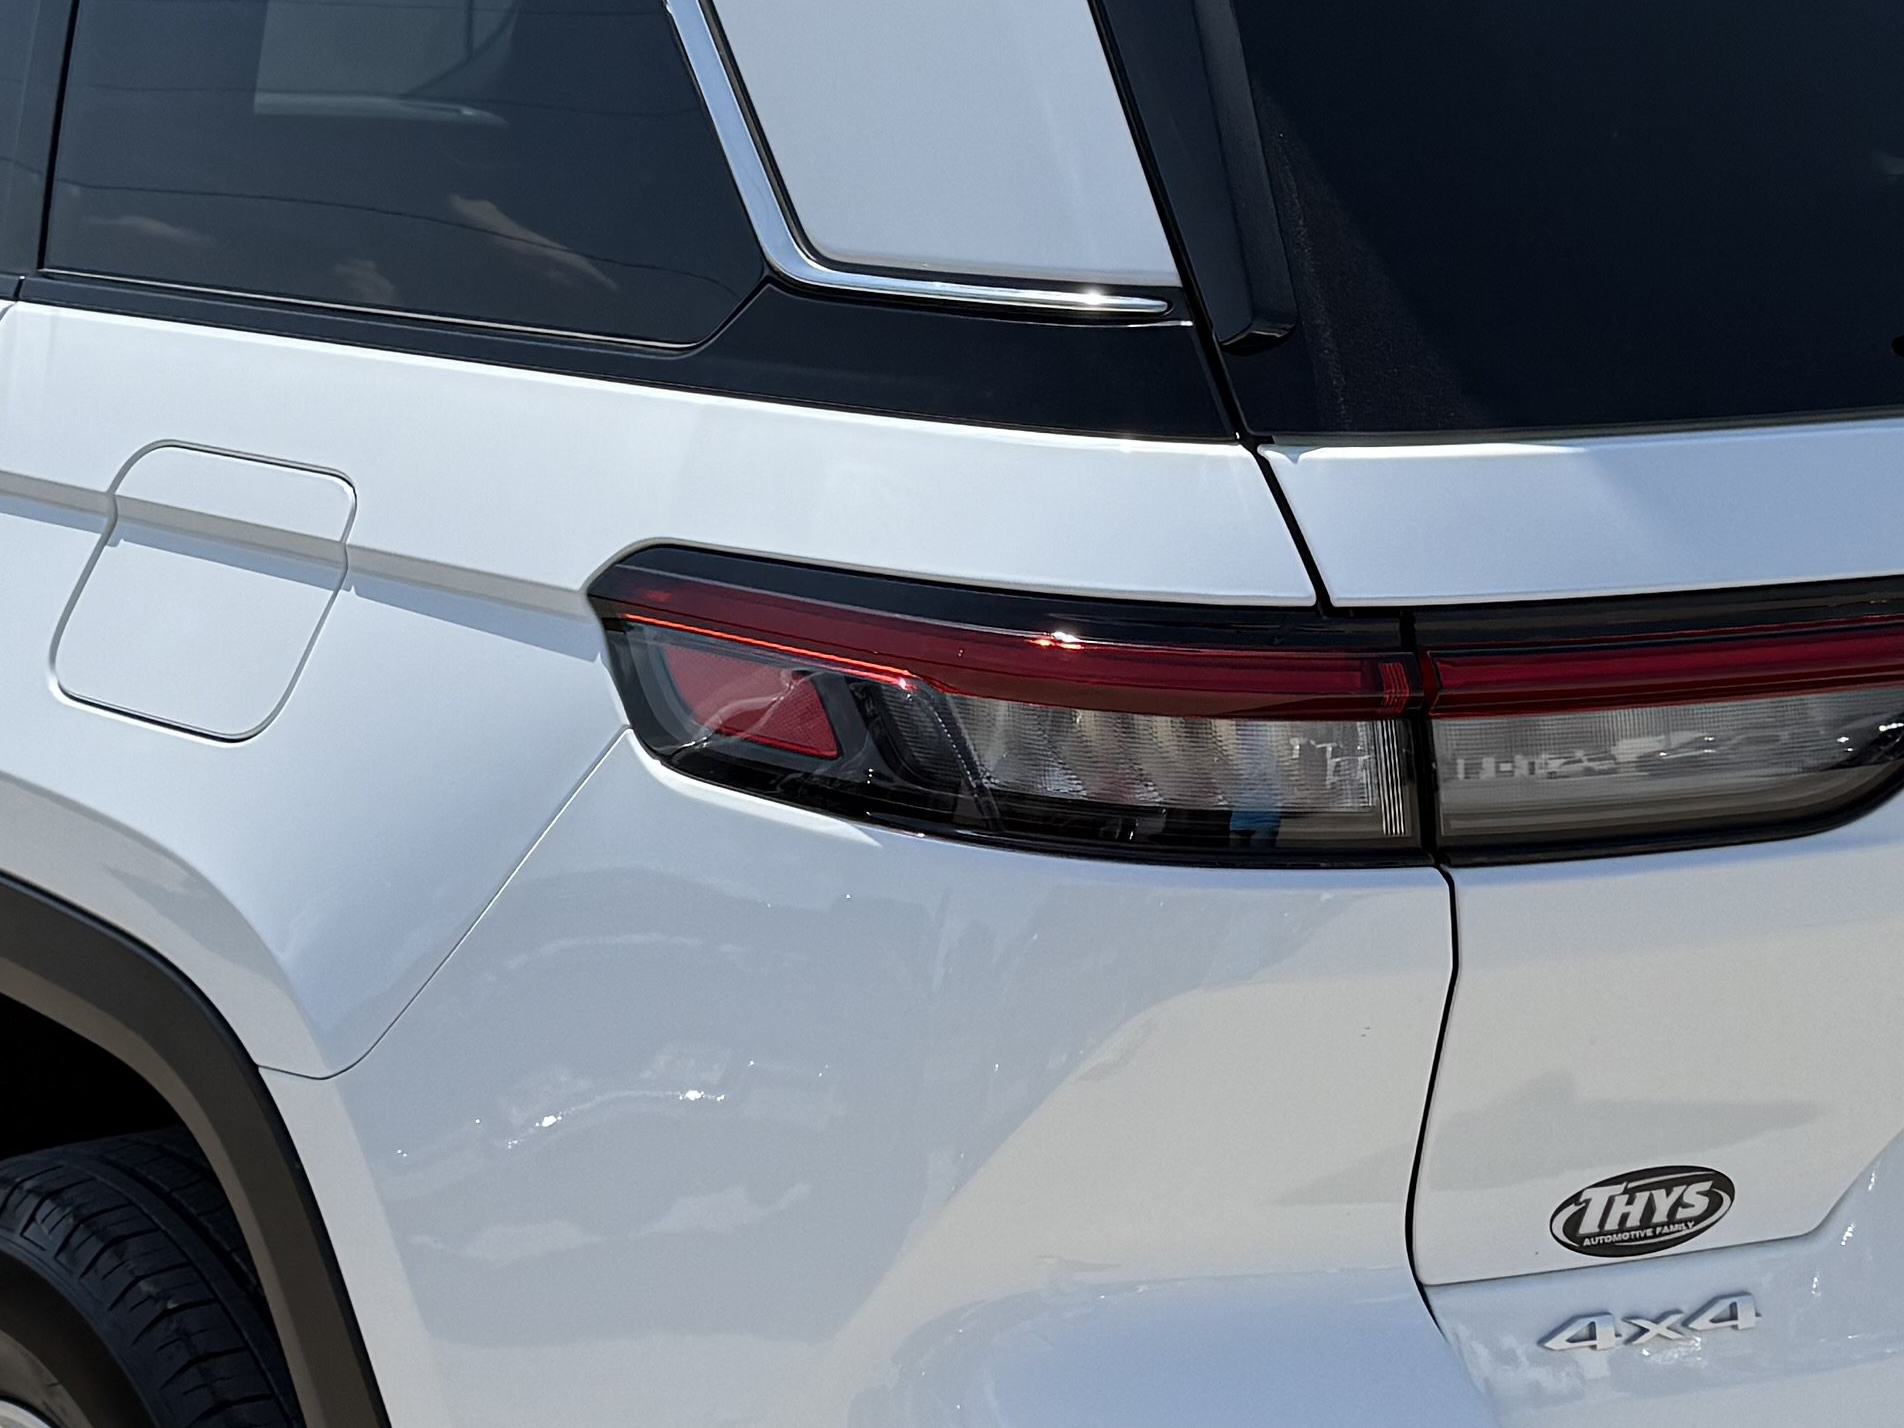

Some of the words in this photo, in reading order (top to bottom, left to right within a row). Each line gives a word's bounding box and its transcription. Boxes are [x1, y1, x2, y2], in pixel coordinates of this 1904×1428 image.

[1572, 1181, 1714, 1237] THYS
[1582, 1226, 1653, 1247] AUTOMOTIVE
[1655, 1220, 1696, 1236] FAMILY
[1537, 1290, 1761, 1351] 4x4
